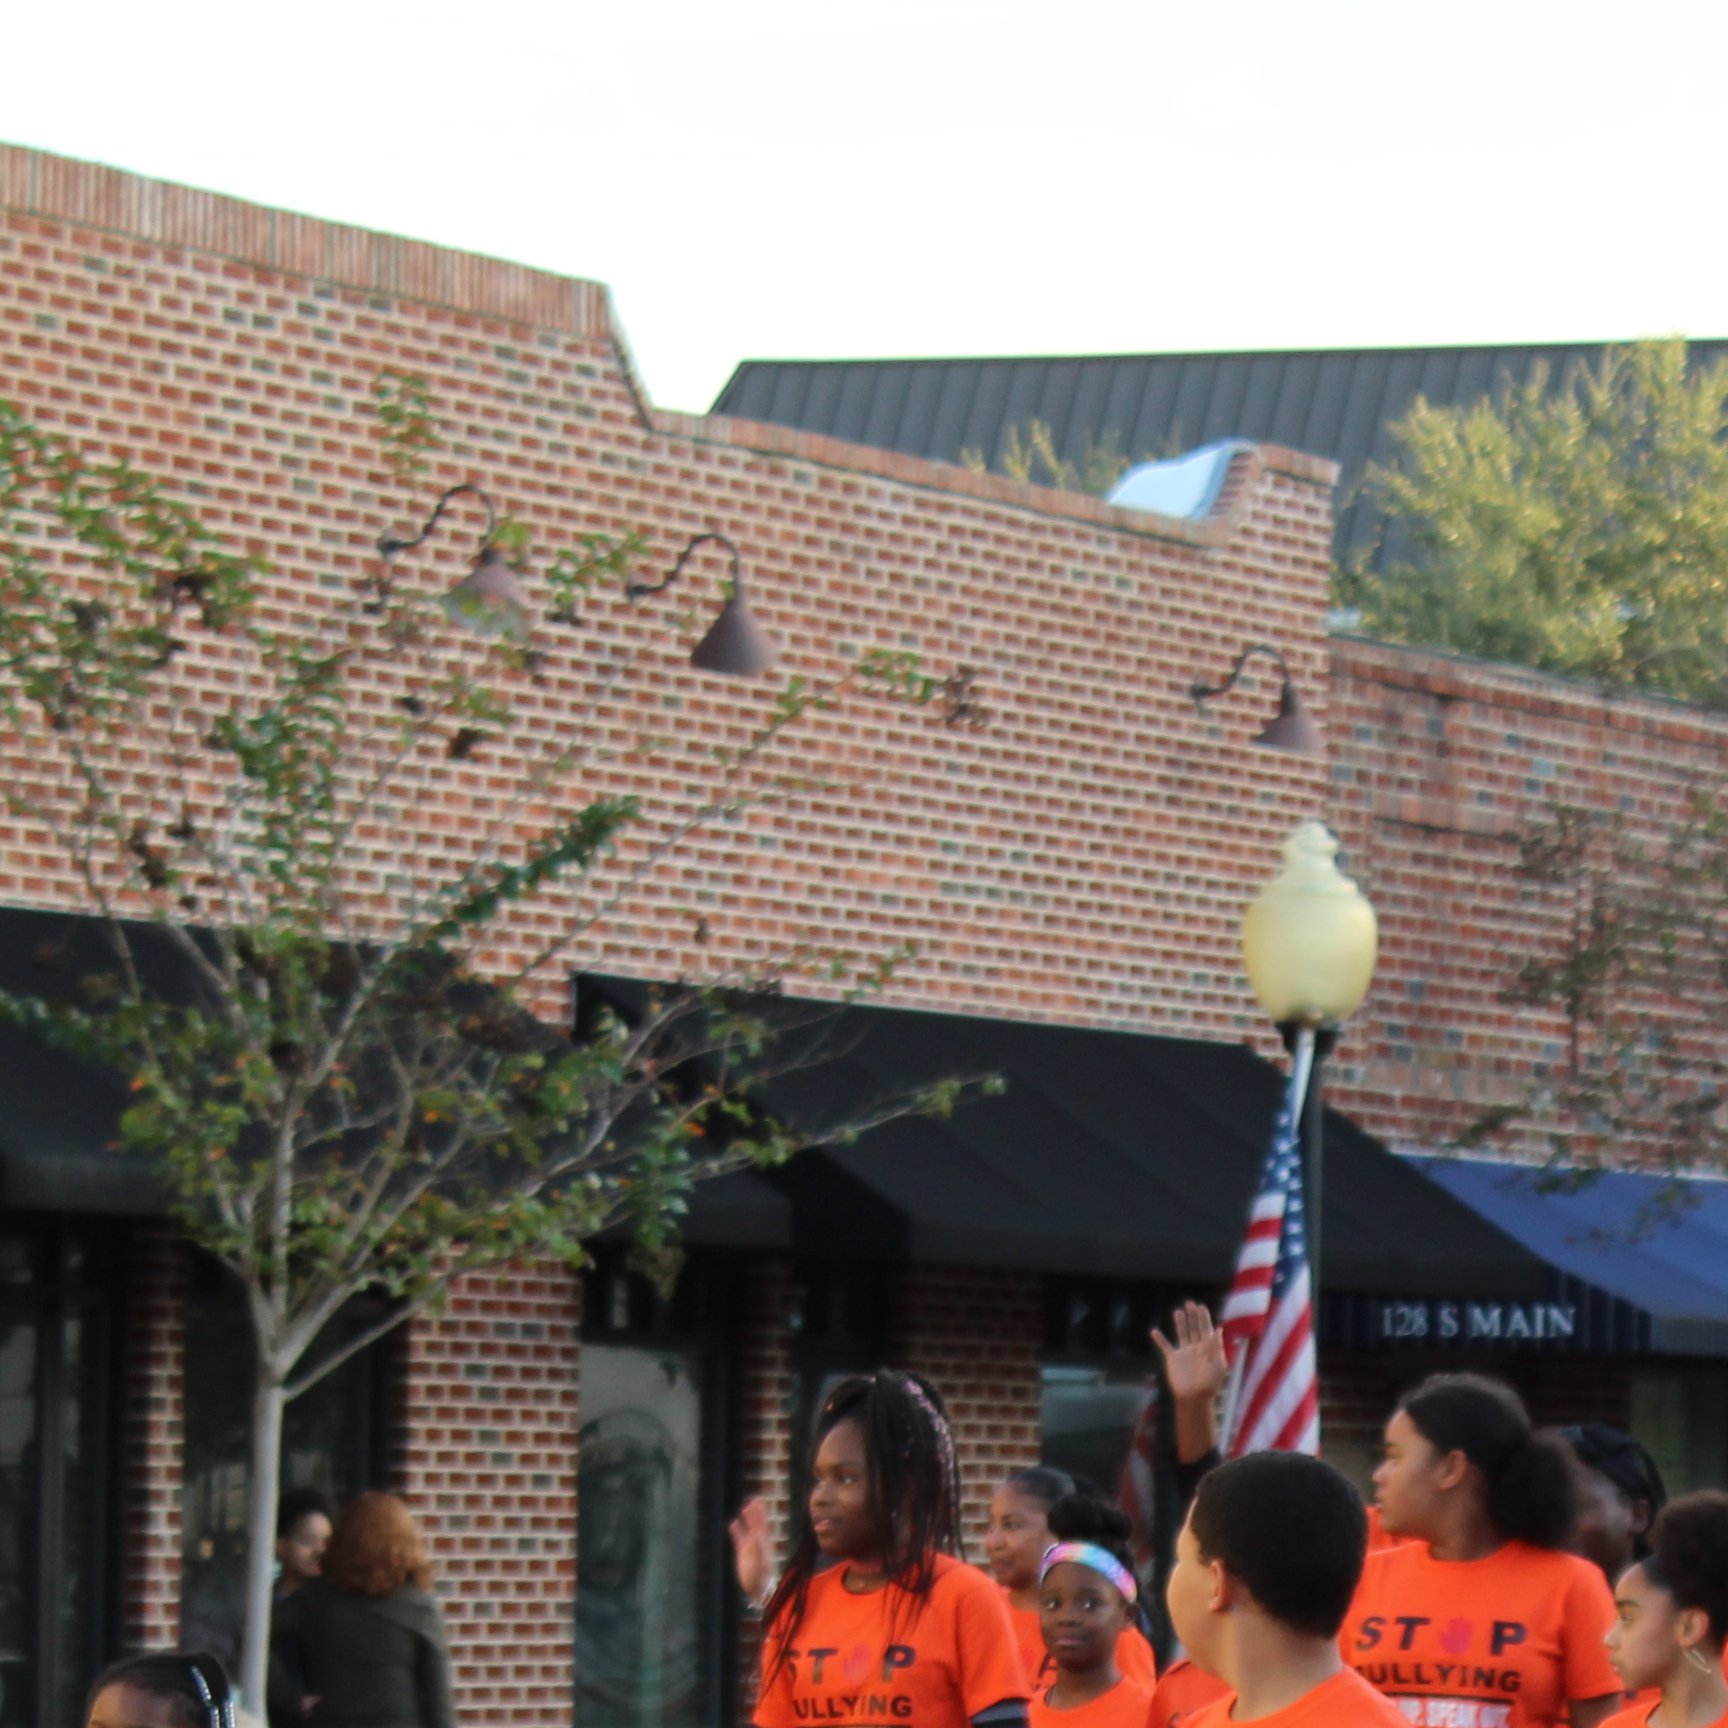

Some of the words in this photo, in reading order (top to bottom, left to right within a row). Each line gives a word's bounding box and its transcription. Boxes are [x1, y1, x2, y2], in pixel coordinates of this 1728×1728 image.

[1383, 1305, 1428, 1338] 128
[1438, 1303, 1460, 1338] S
[1470, 1304, 1576, 1338] MAIN
[793, 1694, 913, 1720] ULLYING
